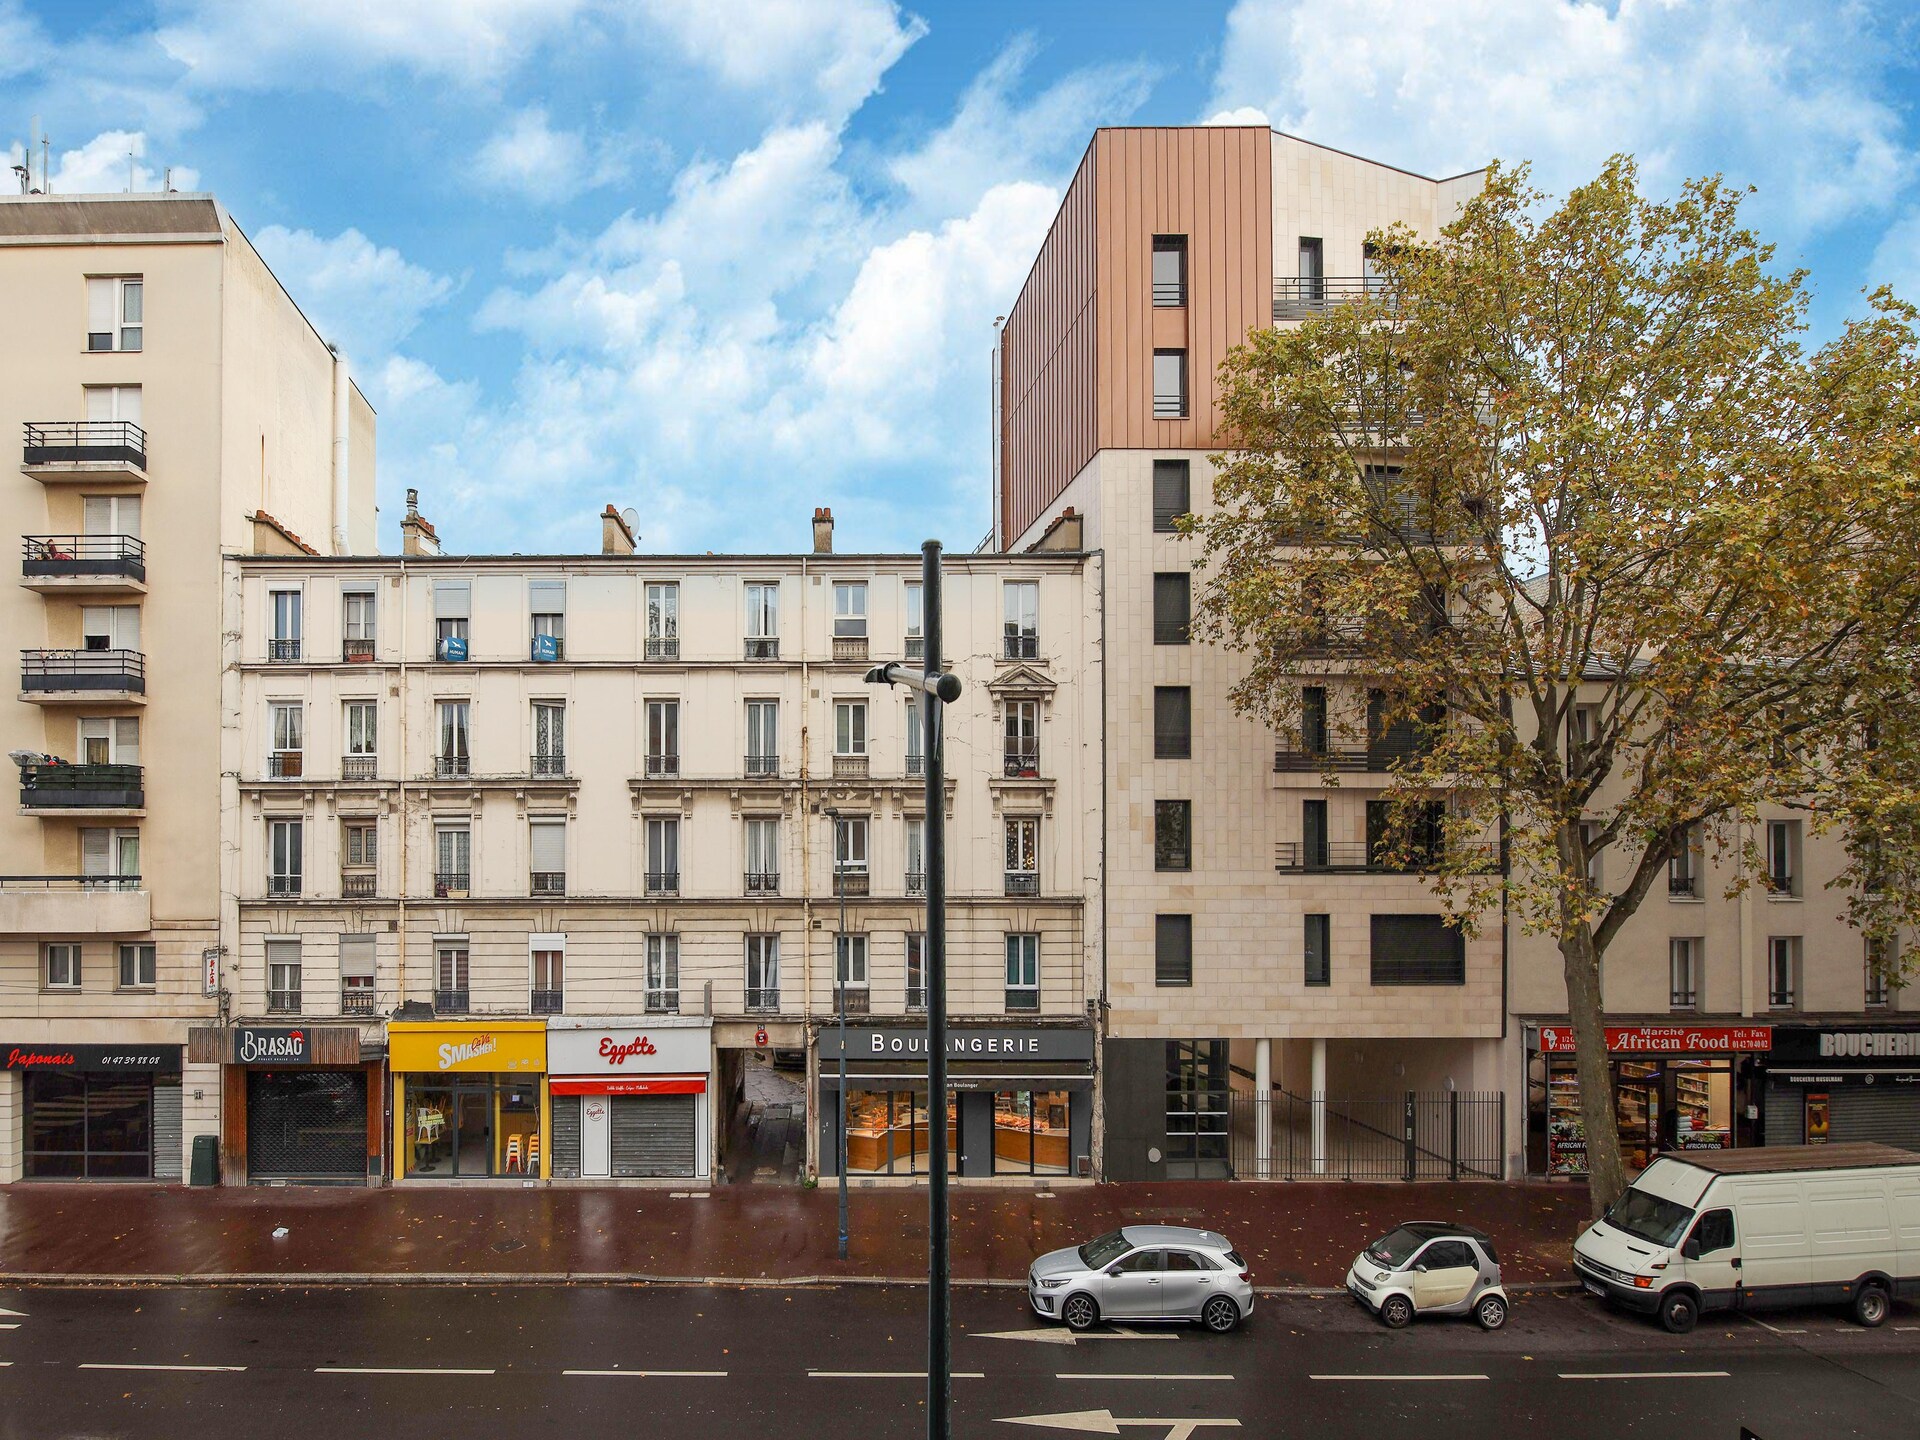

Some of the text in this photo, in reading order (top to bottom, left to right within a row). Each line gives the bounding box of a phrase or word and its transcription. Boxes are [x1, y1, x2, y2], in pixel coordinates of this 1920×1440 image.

[1641, 1028, 1684, 1036] Marché
[871, 1034, 1039, 1052] BOULNGERIE
[1612, 1033, 1680, 1050] African
[1686, 1033, 1729, 1049] Food
[7, 1048, 75, 1068] Japonais
[599, 1036, 657, 1065] Eggette
[101, 1056, 160, 1065] 01 47 39 88 08
[586, 1108, 605, 1117] Eggette
